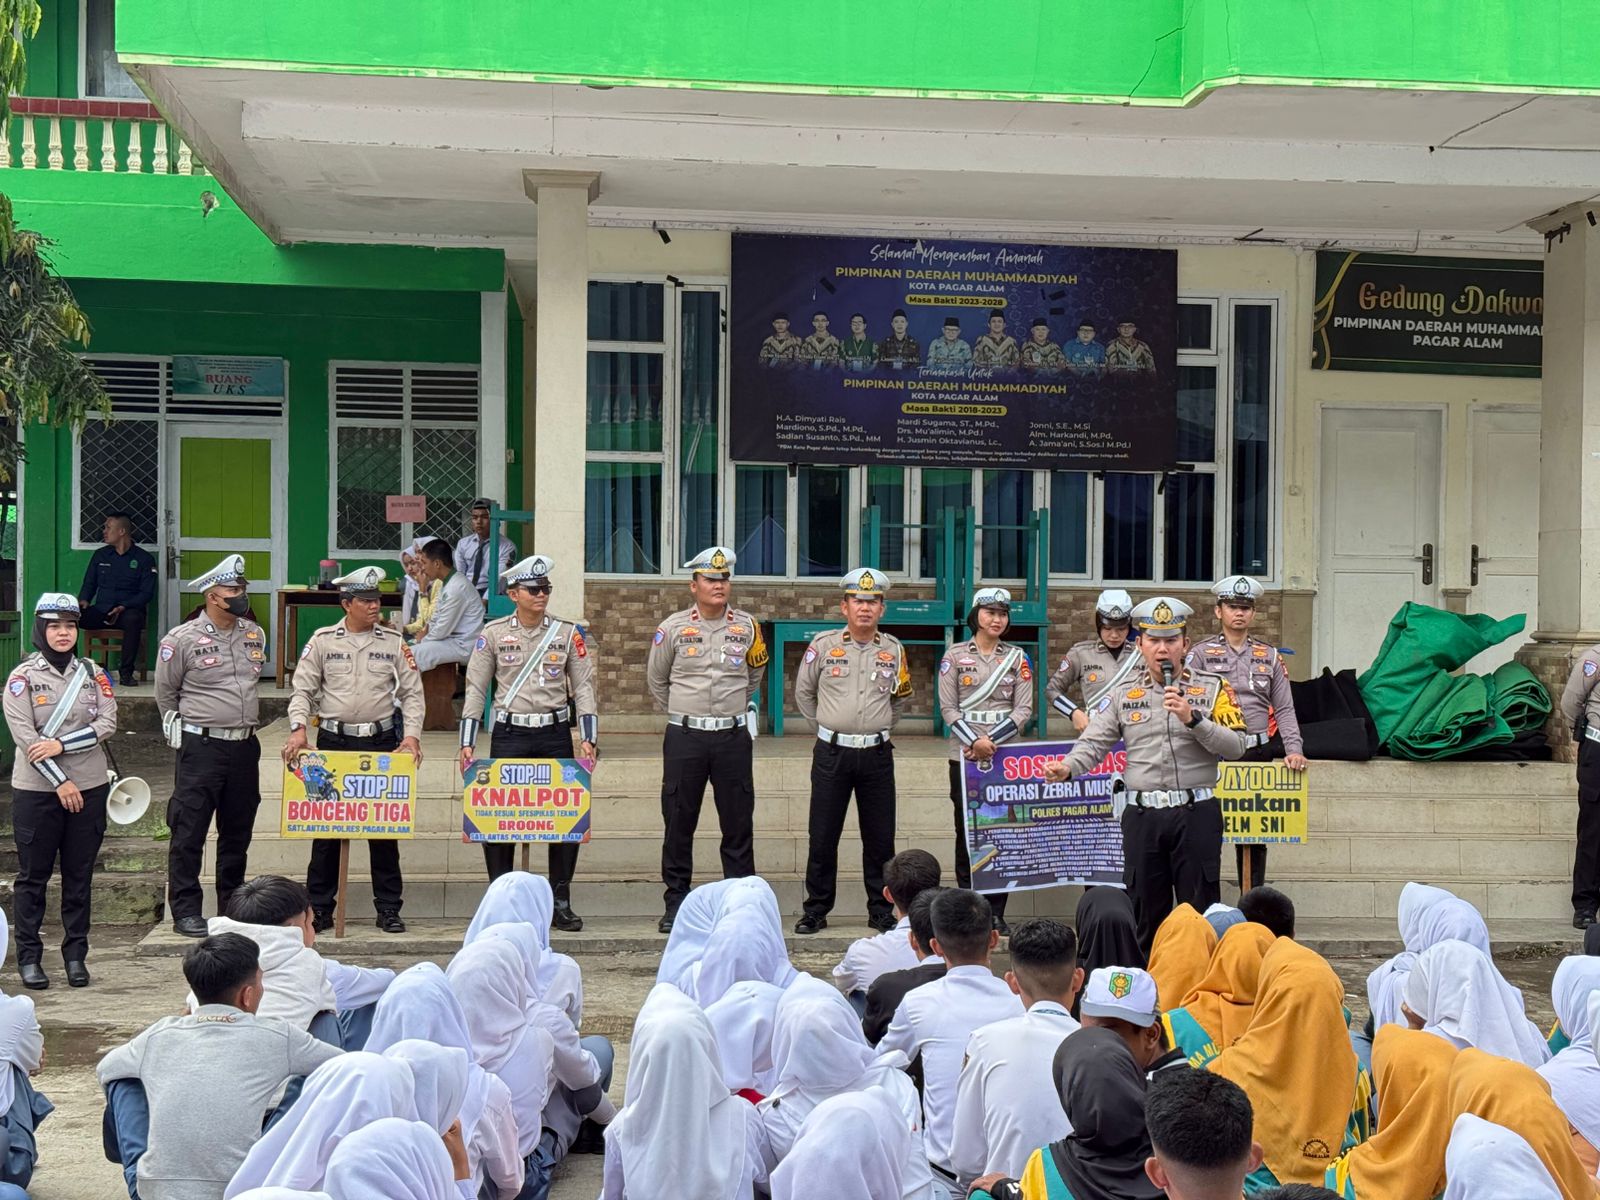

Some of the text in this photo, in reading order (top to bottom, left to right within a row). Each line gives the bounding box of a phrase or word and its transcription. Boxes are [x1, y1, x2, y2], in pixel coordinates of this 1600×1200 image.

[870, 244, 1044, 267] Selamat Mengemban Amanah
[835, 267, 1078, 285] PIMPINAN DAERAH MUHAMMADIYAH
[909, 282, 1005, 293] KOTA PAGAR ALAM
[909, 296, 1003, 307] Masa Bakti 2023-2028
[1359, 281, 1544, 318] Gedung Dakwa
[1333, 317, 1544, 337] PIMPINAN DAERAH MUHAMMA
[1413, 335, 1503, 349] PAGAR ALAM
[205, 374, 253, 383] RUANG
[968, 368, 993, 380] Untuk
[213, 384, 248, 395] UKS
[843, 378, 1067, 394] PIMPINAN DAERAH MUHAMMADIYAH
[911, 392, 999, 402] KOTA PAGAR ALAM
[906, 404, 1002, 414] Masa Bakti 2018-2023
[776, 414, 793, 422] H.A.
[795, 415, 827, 424] Dimyati
[922, 419, 958, 428] Sugama,
[776, 424, 817, 432] Mardiono,
[1029, 422, 1054, 430] Jonni,
[806, 433, 840, 442] Susanto,
[1050, 432, 1089, 440] Harkandi,
[938, 437, 987, 447] Oktavianus,
[725, 636, 747, 644] POLRI
[1187, 699, 1210, 707] OLRI
[985, 779, 1112, 803] OPERASI ZEBRA MUS
[472, 787, 584, 807] KNALPOT
[1223, 793, 1301, 812] nakan
[288, 801, 411, 822] BONCENG TIGA
[1032, 807, 1061, 817] POLRES
[1062, 806, 1088, 816] PAGAR
[288, 824, 330, 832] SATLANTAS
[332, 825, 360, 833] POLRES
[362, 825, 386, 833] PAGAR
[498, 820, 554, 831] BROONG
[1224, 816, 1285, 833] ELM SNI
[470, 833, 582, 841] SATLANTAS POLRES PAGAR ALAM
